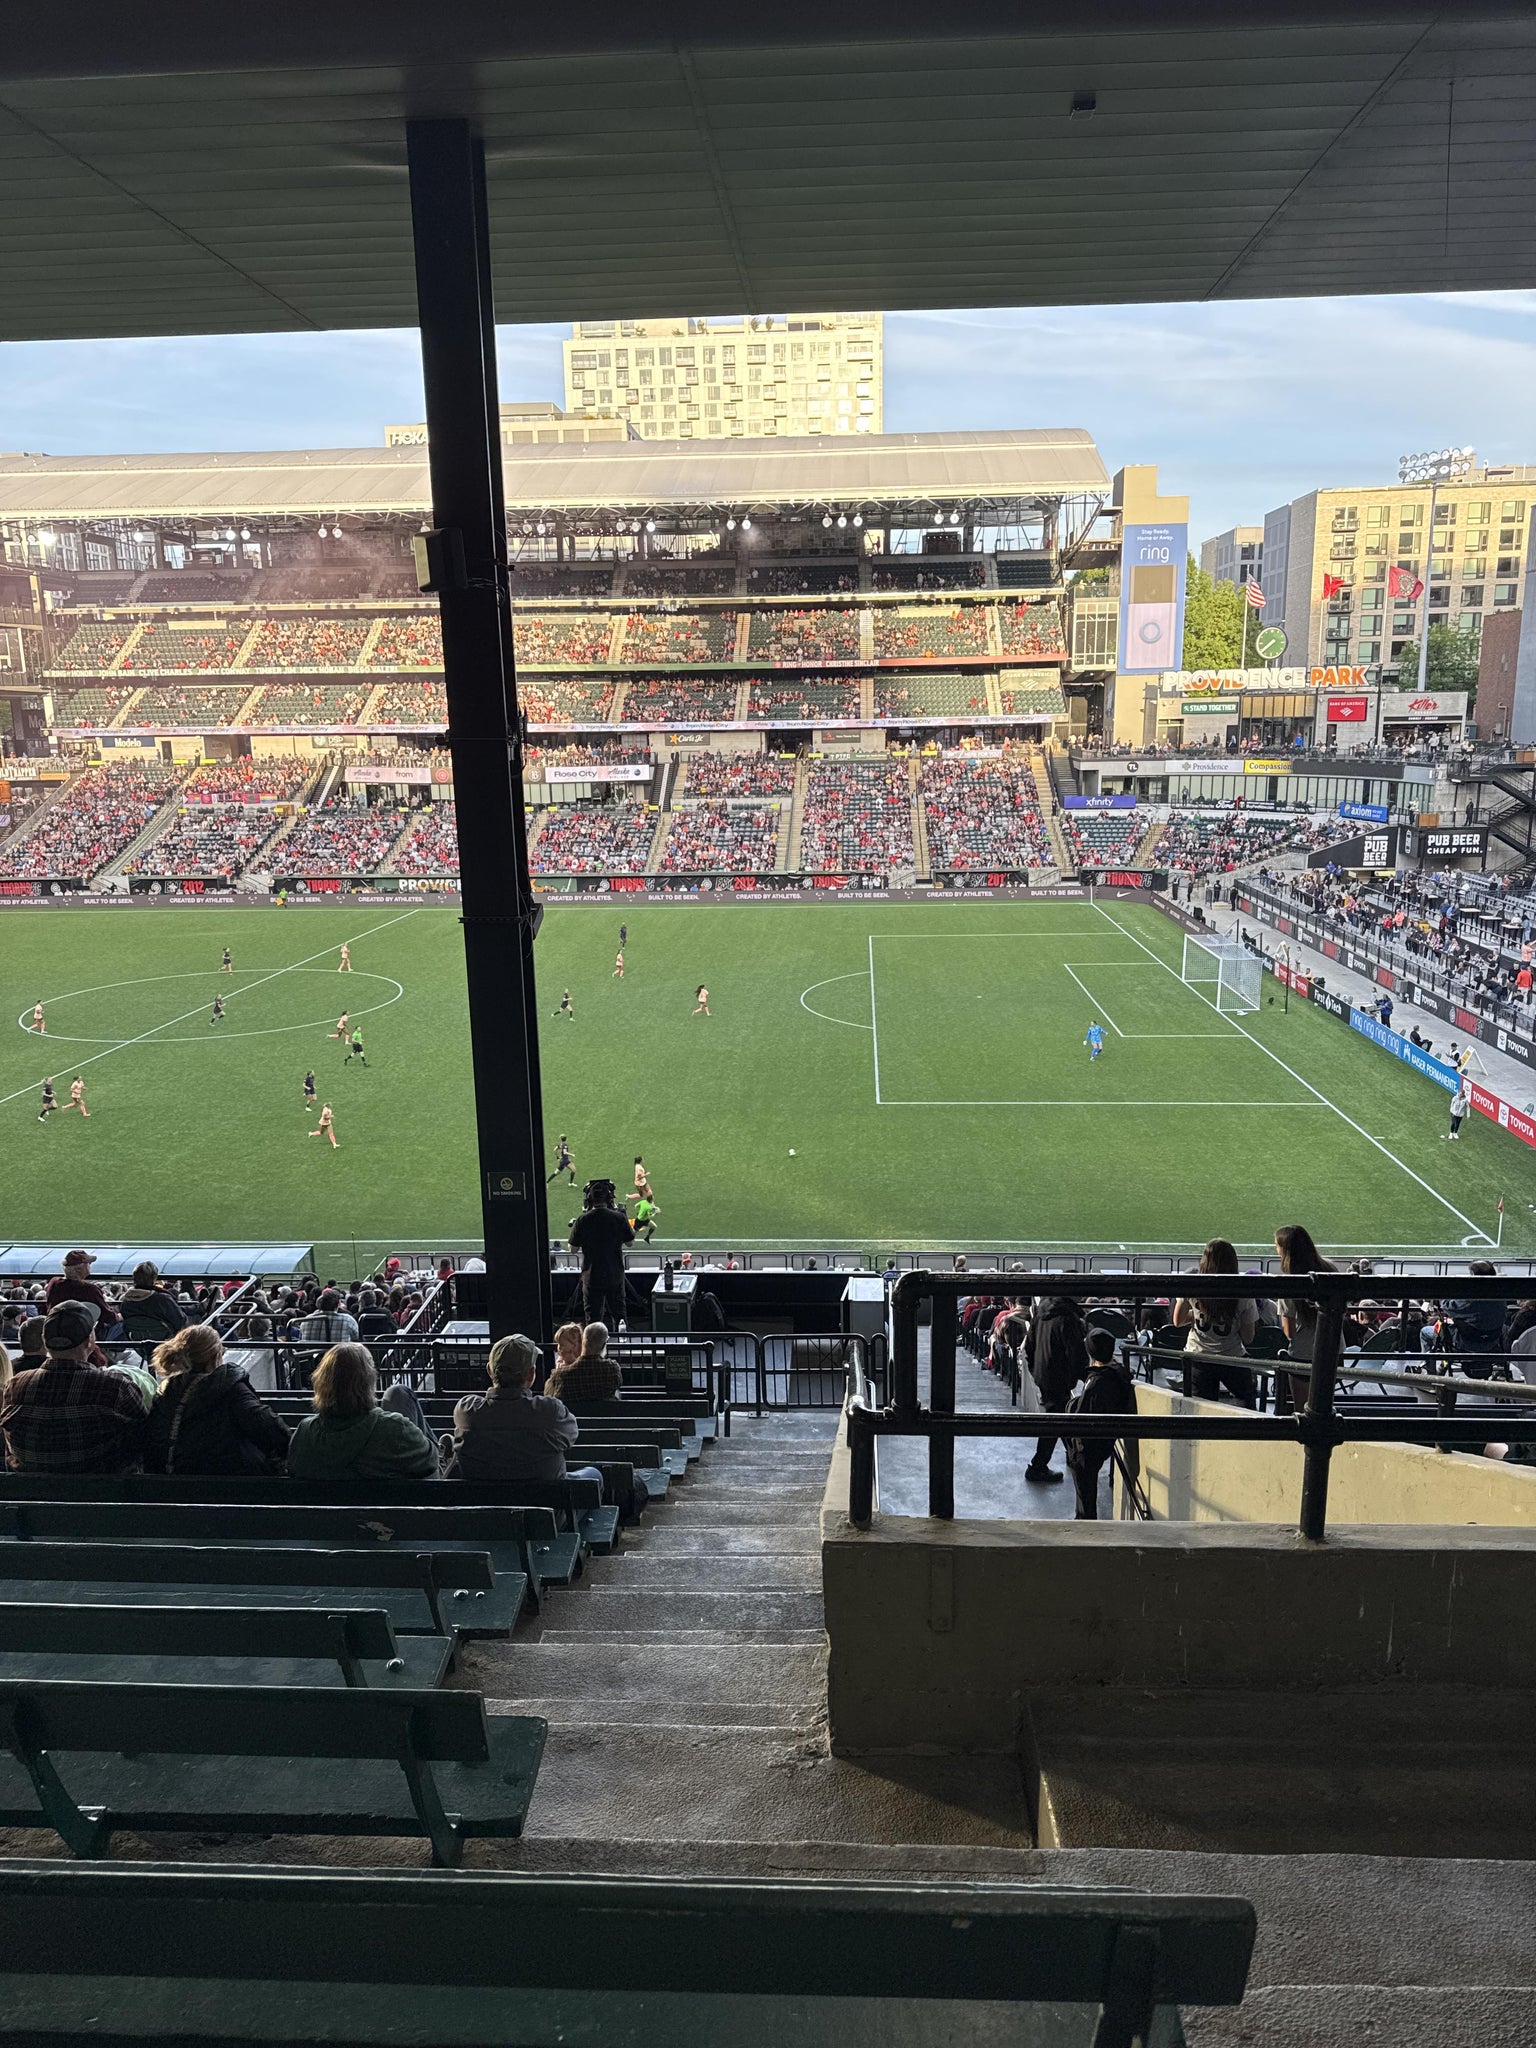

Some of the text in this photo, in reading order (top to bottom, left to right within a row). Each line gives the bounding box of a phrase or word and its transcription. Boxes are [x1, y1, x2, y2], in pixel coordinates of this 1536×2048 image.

[1140, 544, 1170, 563] ring
[1162, 665, 1370, 692] PROVIDENCE PARK
[114, 738, 141, 746] Modelo
[1192, 762, 1228, 771] Providence
[1249, 763, 1292, 772] Compassion
[579, 770, 597, 778] City
[1086, 798, 1114, 808] xfinity
[1216, 800, 1235, 808] Ford
[1351, 805, 1372, 817] axiom
[1364, 841, 1388, 852] PUB
[1428, 834, 1480, 846] PUB BEER
[1363, 852, 1387, 861] BEER
[183, 880, 205, 894] 2012
[306, 880, 341, 892] THORNS
[734, 877, 756, 890] 2012
[1143, 874, 1152, 887] FC
[1314, 990, 1342, 1014] First Tech
[1422, 995, 1438, 1010] TOYOTA
[1364, 1020, 1374, 1038] ring
[1375, 1027, 1386, 1046] ring
[1388, 1035, 1399, 1054] ring
[1508, 1040, 1528, 1058] TOYOTA
[1411, 1054, 1426, 1071] KAISER
[1473, 1090, 1494, 1112] TOYOTA
[1510, 1115, 1534, 1138] TOYOTA
